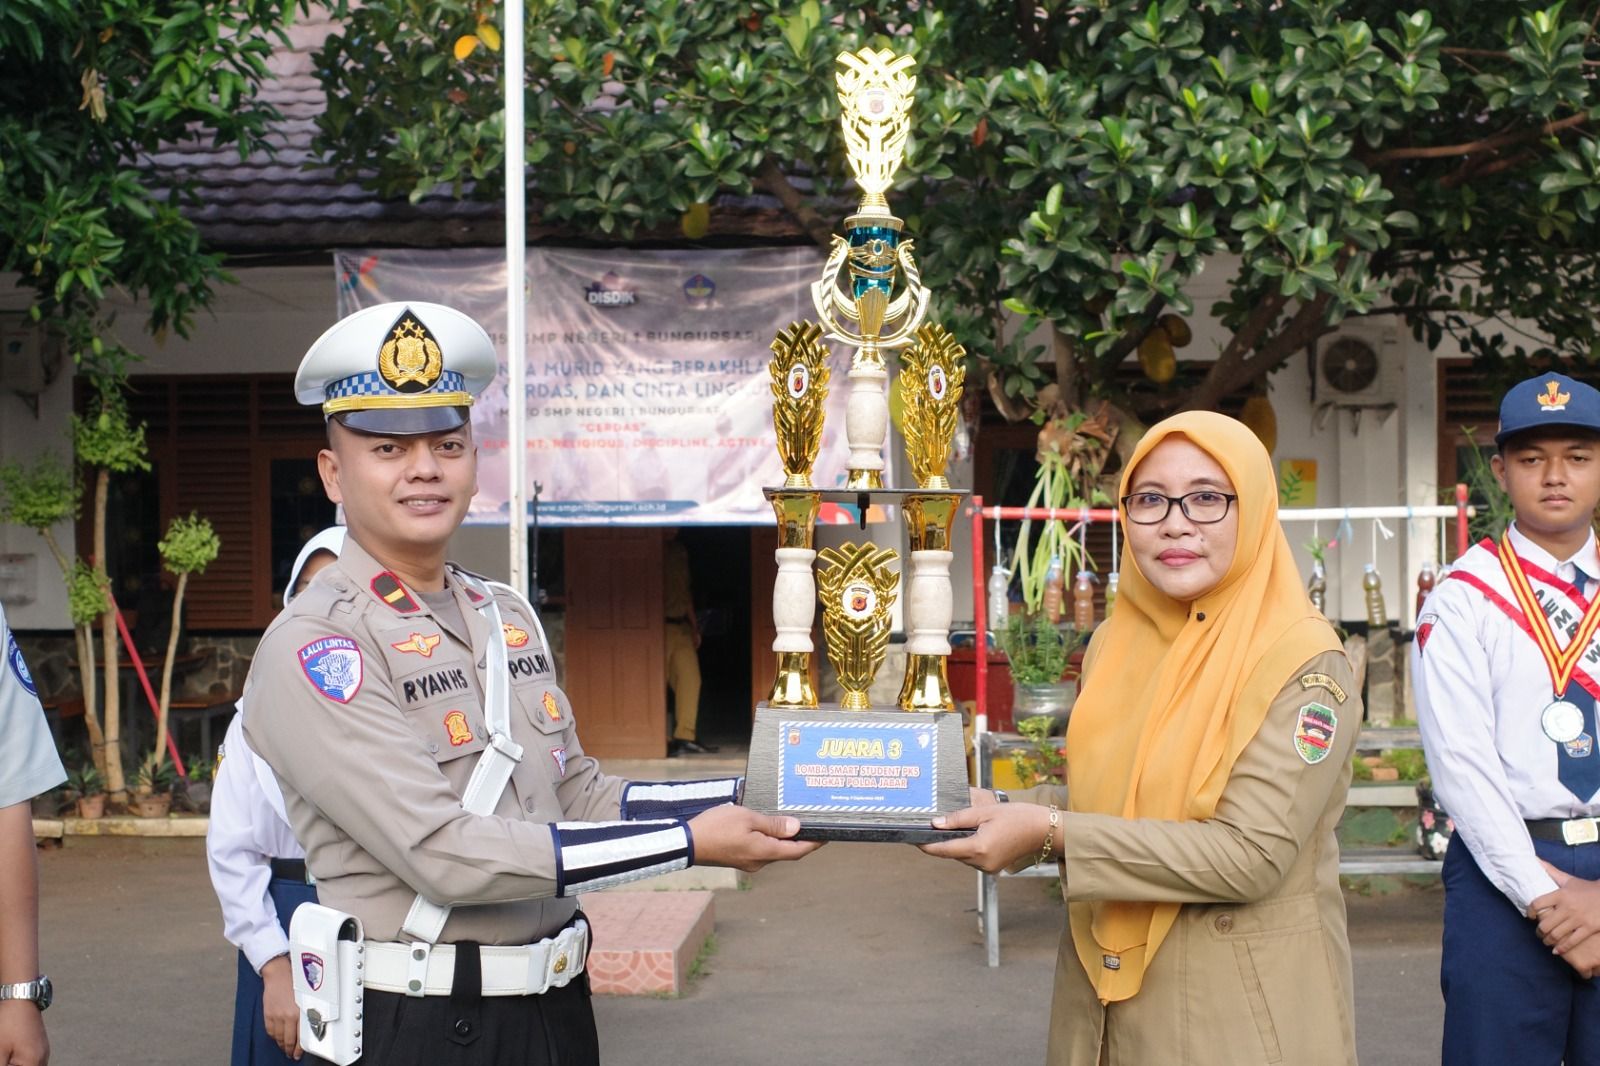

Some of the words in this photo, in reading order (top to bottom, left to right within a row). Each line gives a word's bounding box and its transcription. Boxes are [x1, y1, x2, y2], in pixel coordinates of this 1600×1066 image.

[588, 291, 635, 304] DISDIK
[563, 331, 627, 345] NEGERI
[544, 360, 604, 377] MURID
[612, 360, 665, 376] YANG
[671, 360, 770, 376] BERAKHLA
[503, 381, 579, 400] CRDAS,
[585, 381, 625, 399] DAN
[632, 381, 688, 398] CINTA
[544, 407, 573, 417] SMP
[301, 641, 324, 660] LALU
[323, 638, 356, 650] LINTAS
[507, 653, 551, 680] POLRI
[402, 669, 452, 704] RYAN
[447, 667, 469, 690] HS
[817, 738, 885, 758] JUARA
[887, 739, 903, 759] 3
[795, 764, 828, 776] LOMBA
[828, 765, 860, 776] SMART
[860, 765, 901, 777] STUDENT
[901, 766, 920, 778] PKS
[806, 776, 845, 788] TINGKAT
[846, 777, 878, 788] POLDA
[878, 777, 908, 789] JABAR
